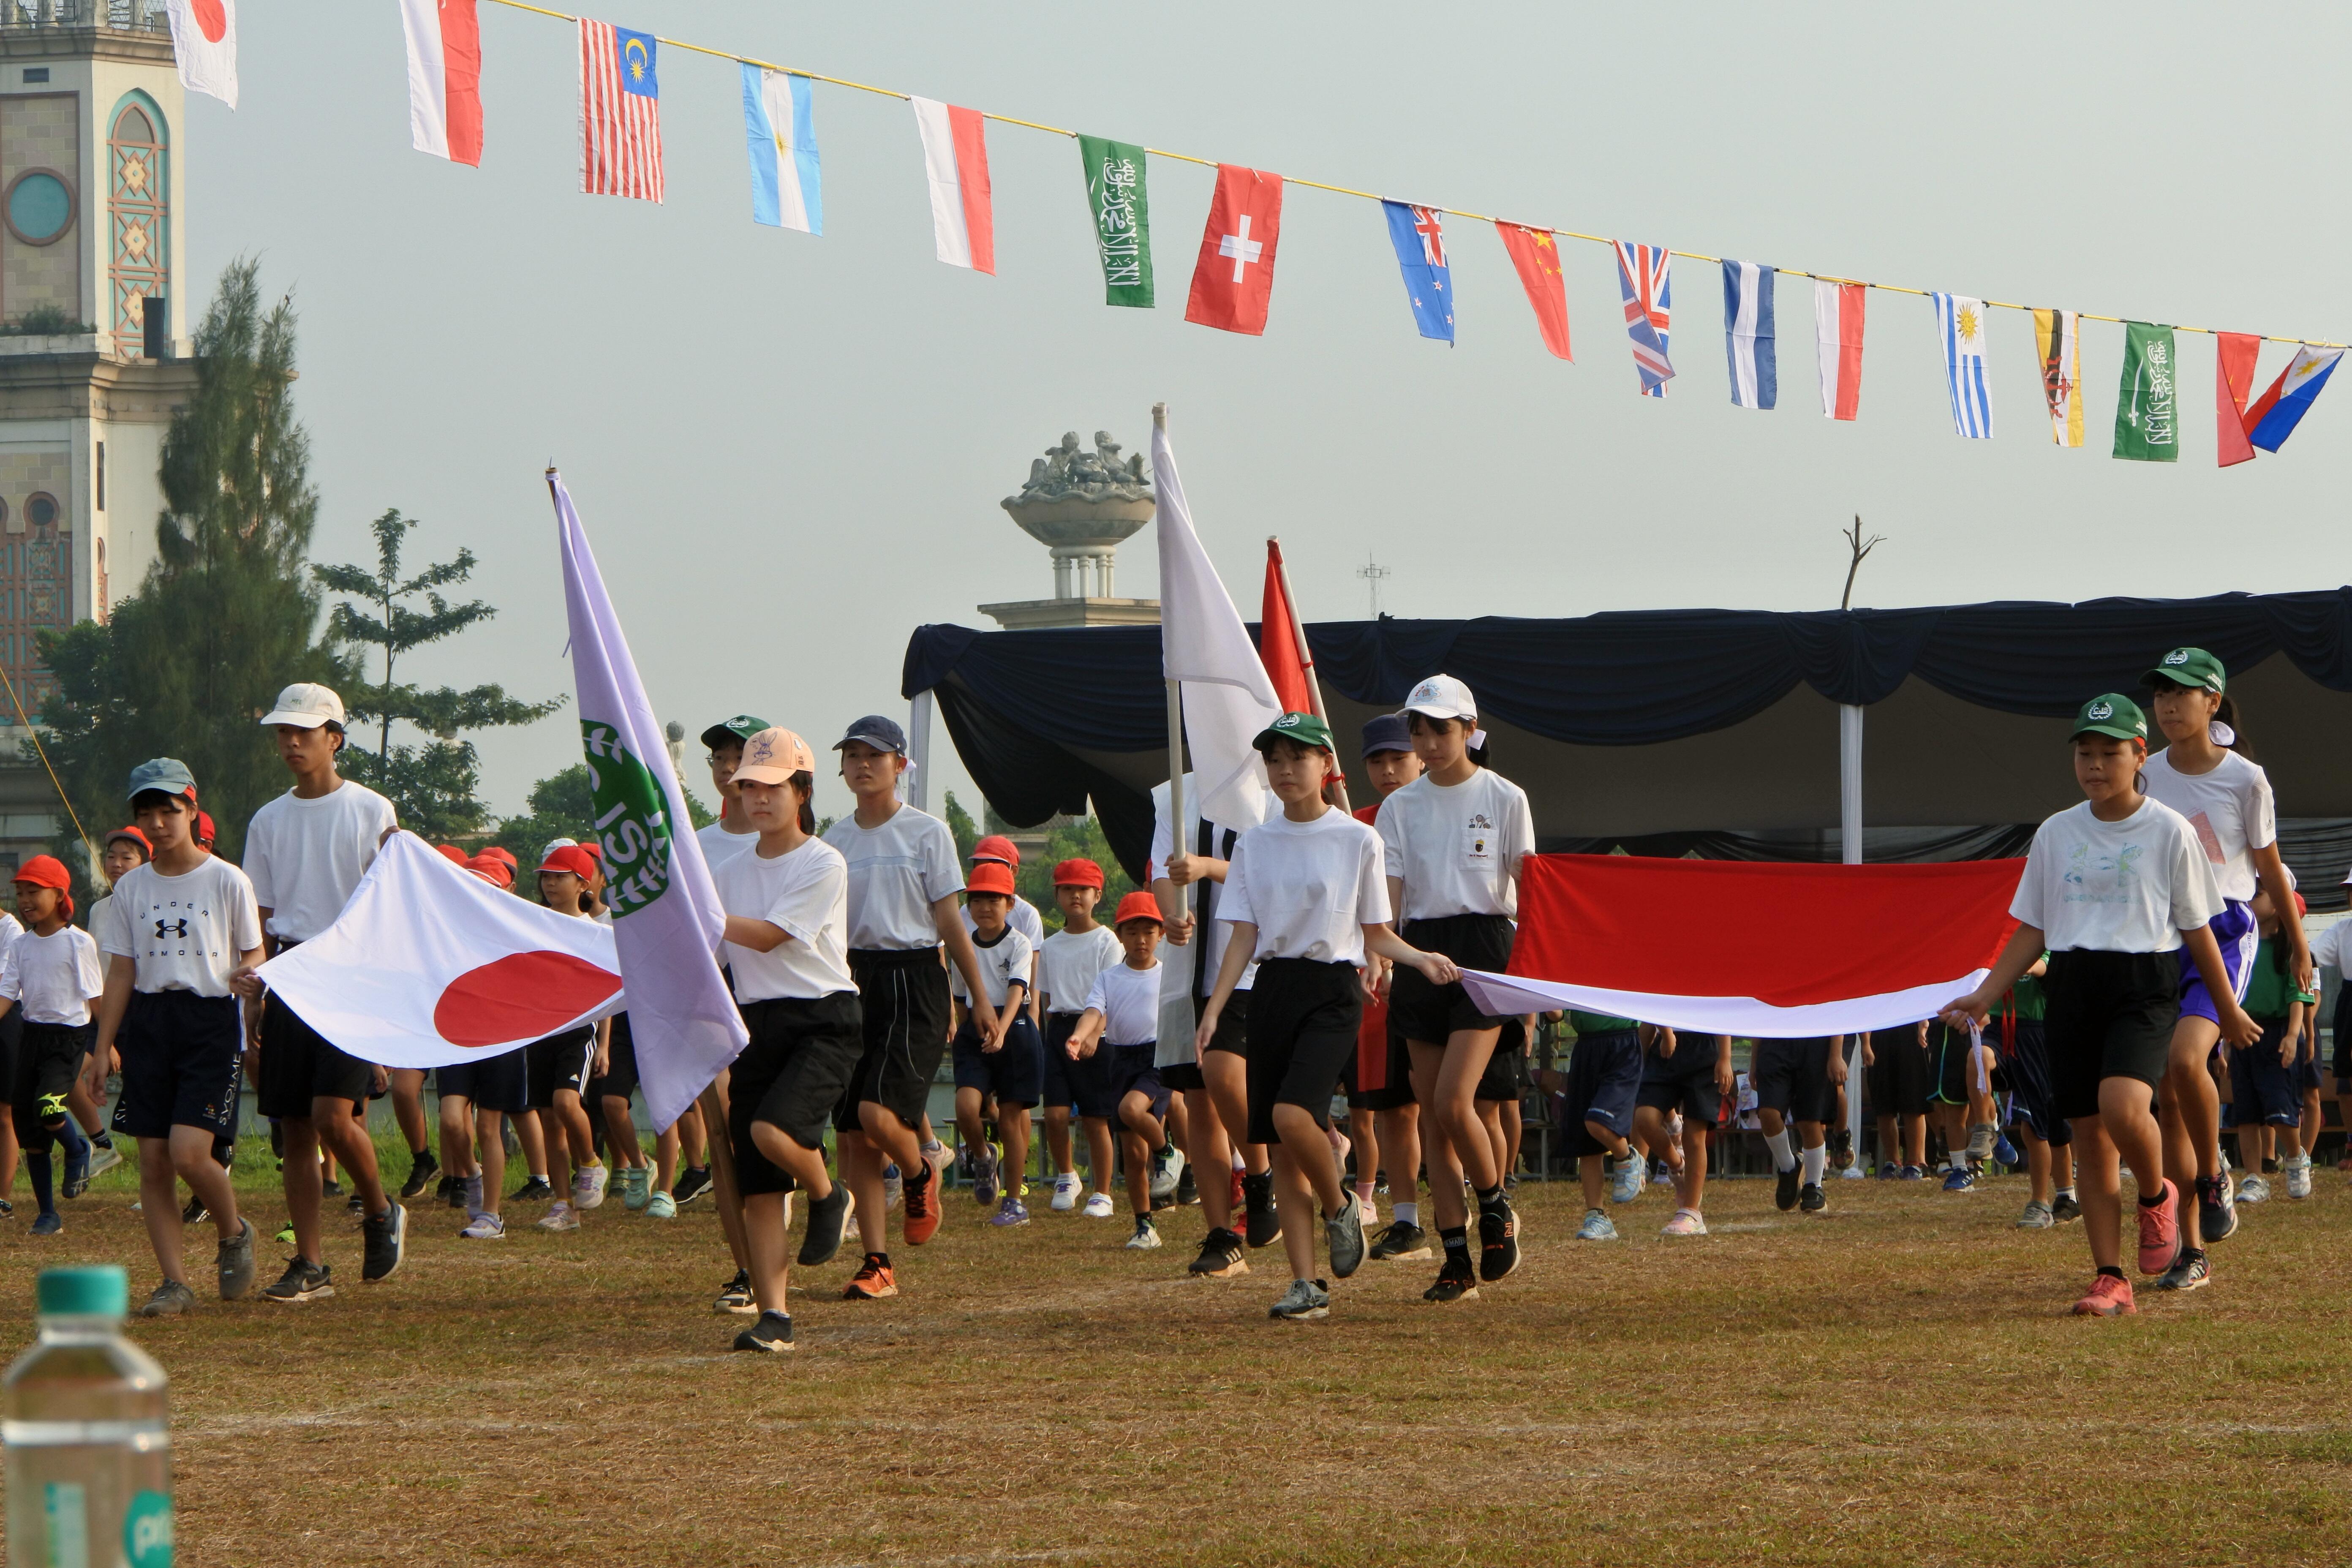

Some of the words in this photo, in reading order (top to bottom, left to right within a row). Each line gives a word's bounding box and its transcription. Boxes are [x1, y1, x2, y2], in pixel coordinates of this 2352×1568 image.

[140, 901, 208, 919] UNDER
[136, 950, 218, 959] ARMOUR
[219, 1053, 241, 1126] SVOLME
